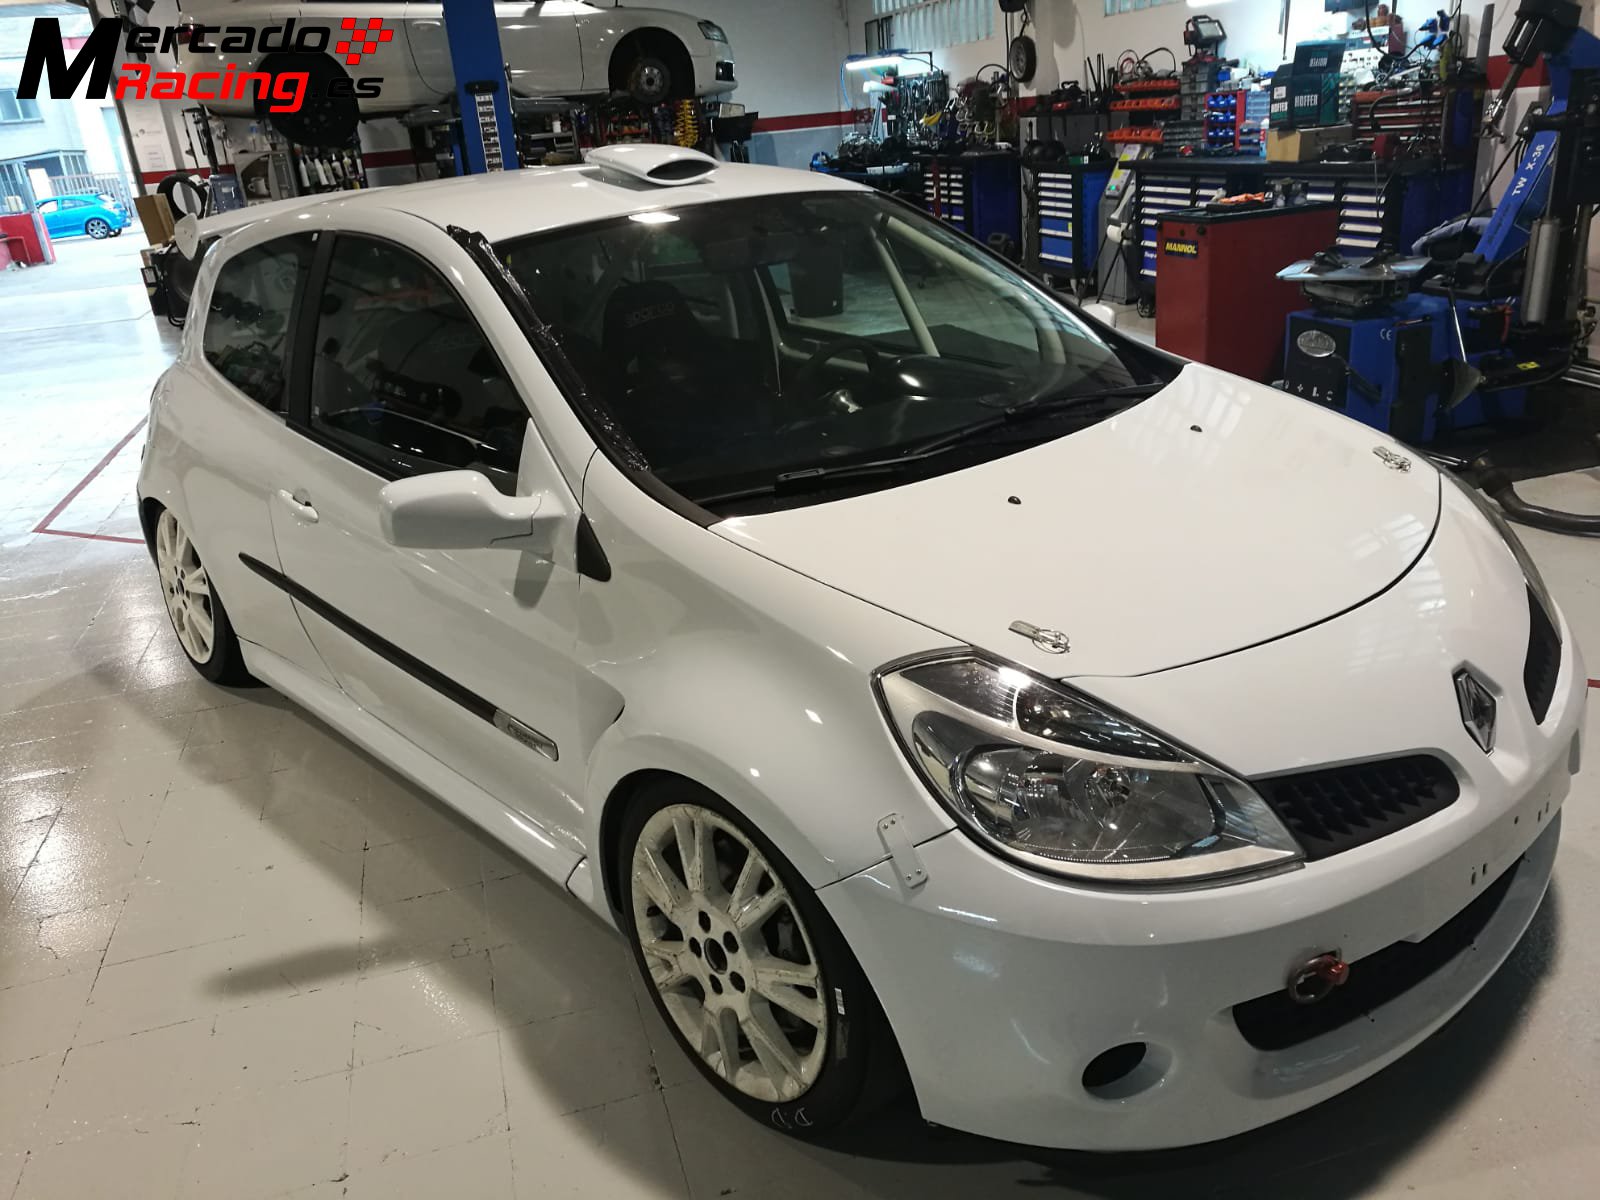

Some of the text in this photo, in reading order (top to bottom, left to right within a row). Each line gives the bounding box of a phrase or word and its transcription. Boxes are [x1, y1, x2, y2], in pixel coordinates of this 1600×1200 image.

[1294, 94, 1318, 107] HOFFER
[1511, 177, 1527, 196] TW
[1165, 242, 1197, 254] MANNOL
